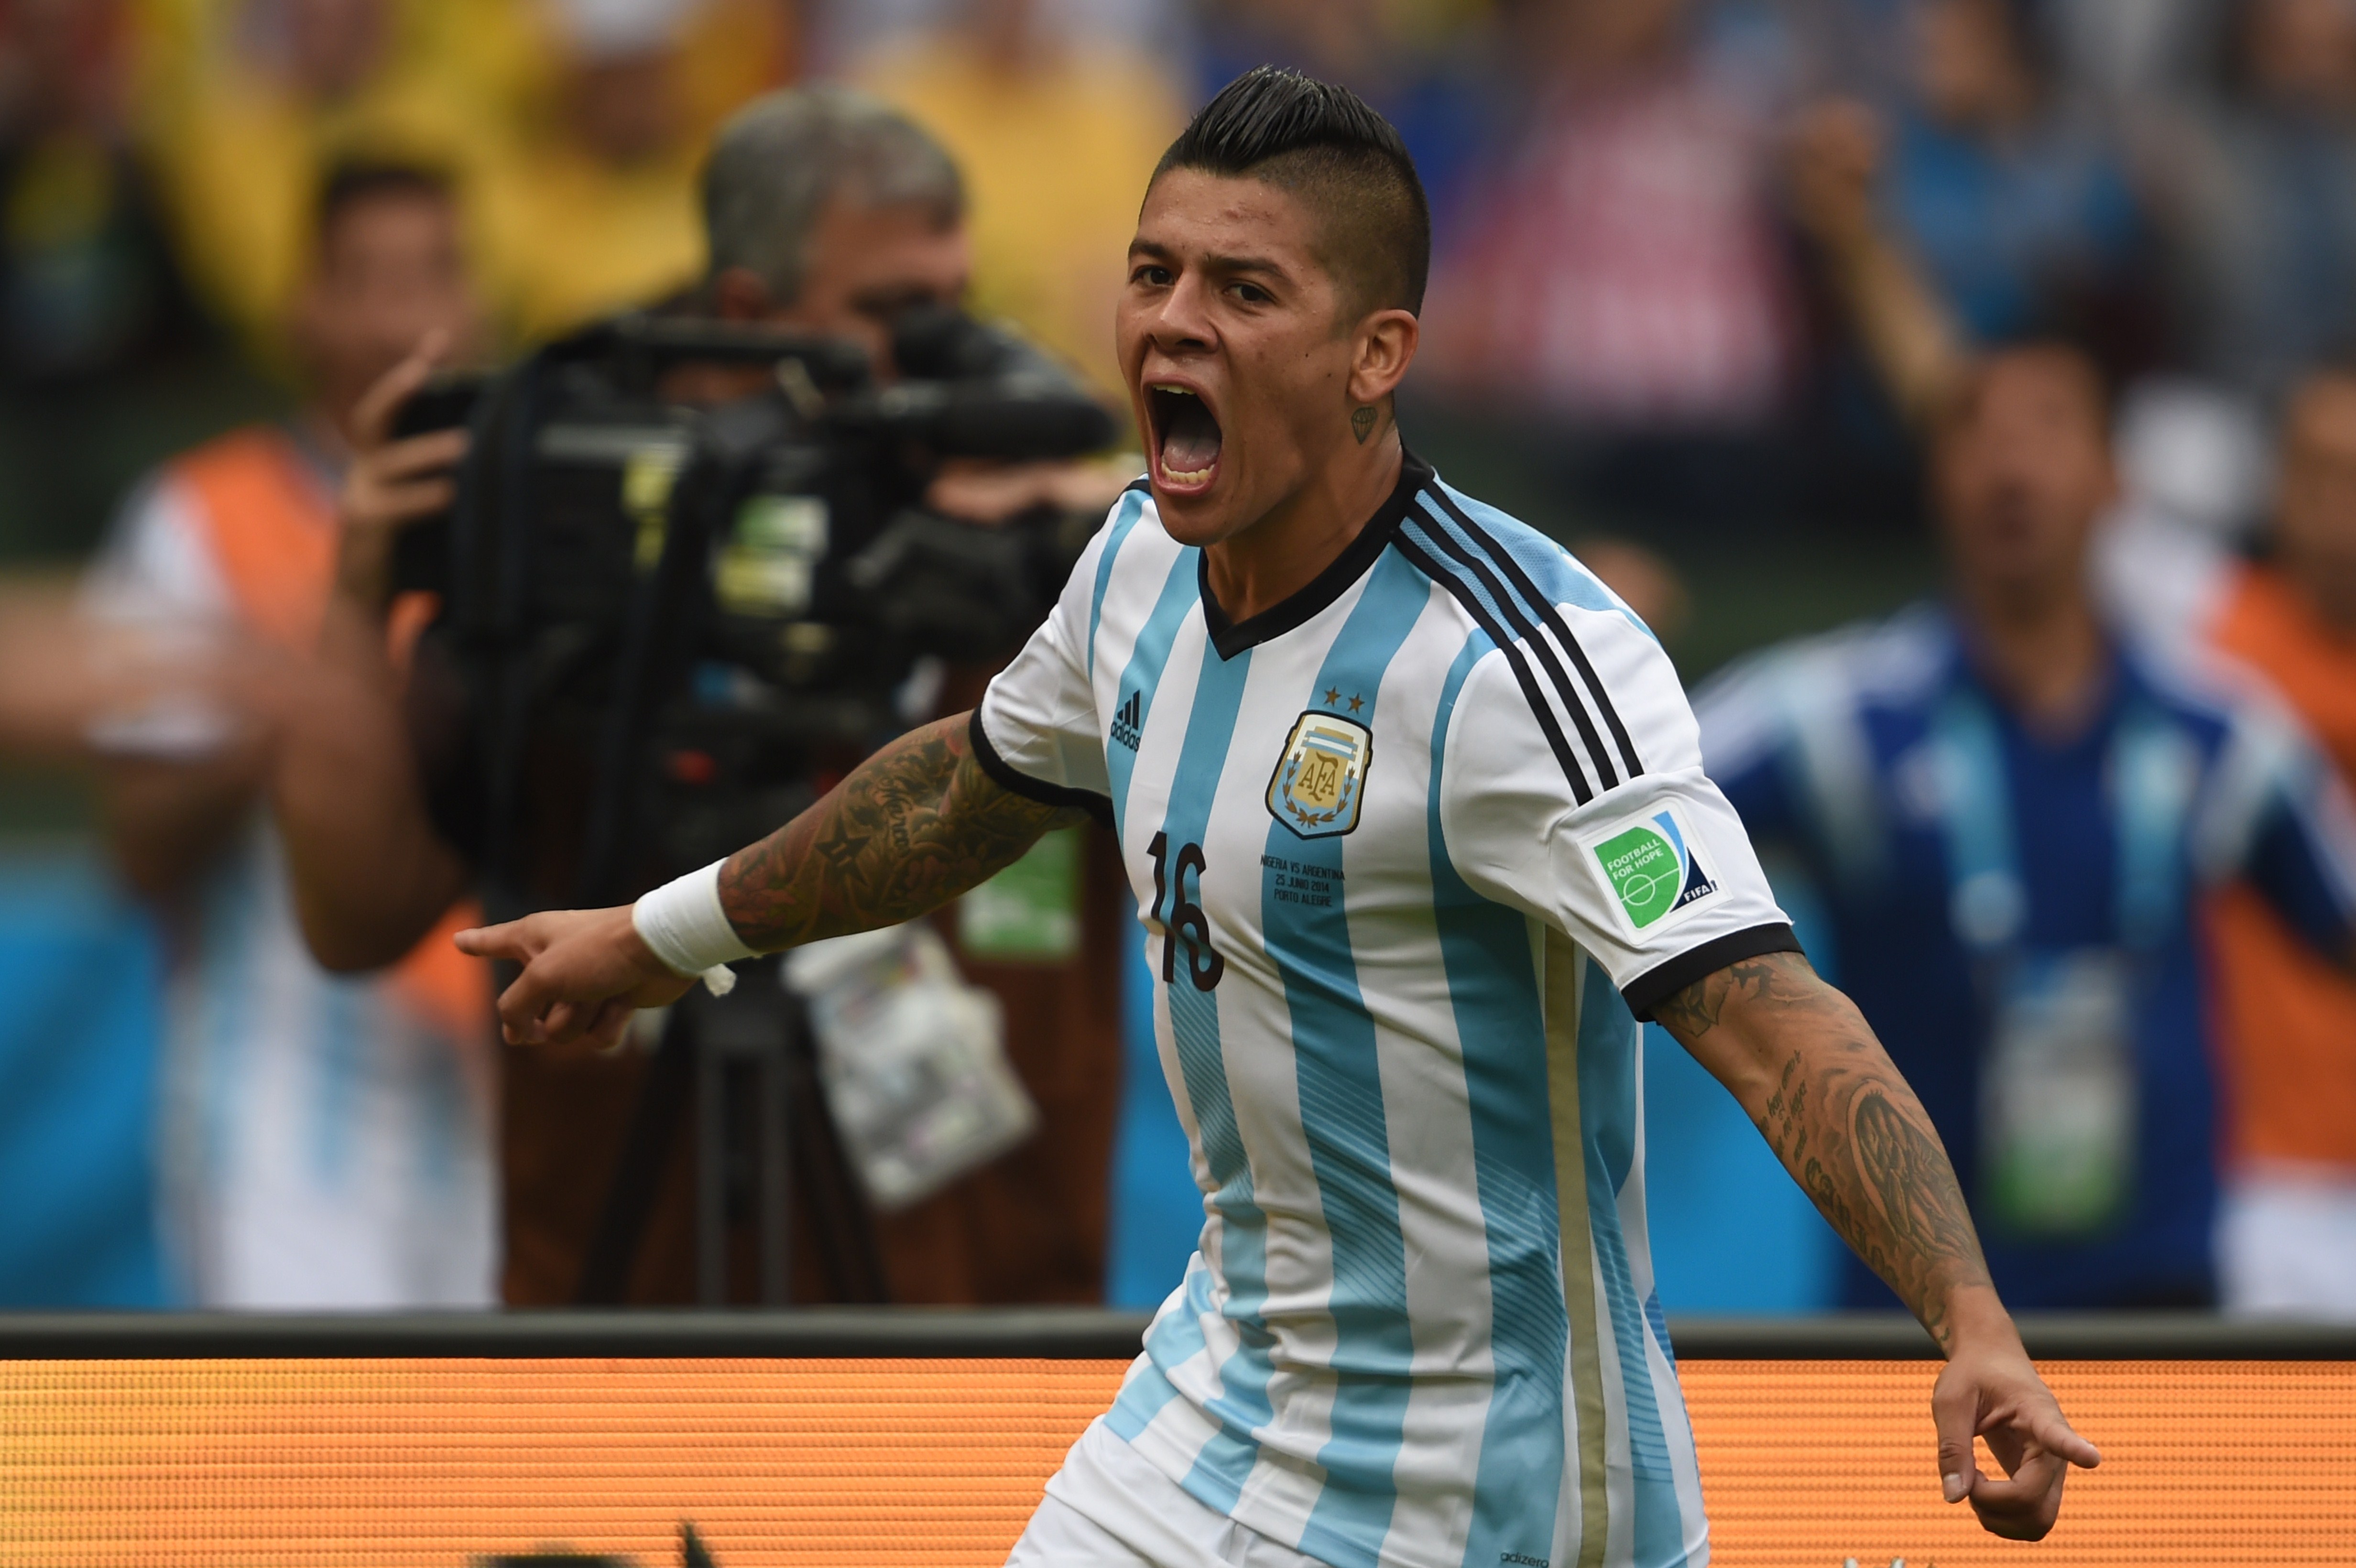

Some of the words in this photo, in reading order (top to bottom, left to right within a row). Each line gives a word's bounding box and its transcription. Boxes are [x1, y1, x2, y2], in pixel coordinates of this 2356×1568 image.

[1111, 721, 1141, 752] adidas
[1298, 751, 1338, 801] AFA
[1260, 854, 1287, 871] NIGERIA
[1290, 861, 1300, 873] VS
[1302, 864, 1345, 881] ARGENTINA
[1607, 839, 1660, 871] FOOTBALL
[1612, 865, 1634, 881] FOR
[1635, 848, 1663, 869] HOPE
[1274, 888, 1299, 902] PORTO
[1301, 893, 1332, 907] ALEGRE
[1276, 873, 1285, 886] 25
[1287, 875, 1309, 890] JUNIO
[1311, 881, 1330, 893] 2014
[1683, 886, 1711, 902] FIFA
[1146, 830, 1224, 992] 16
[1500, 1552, 1549, 1568] adizero
